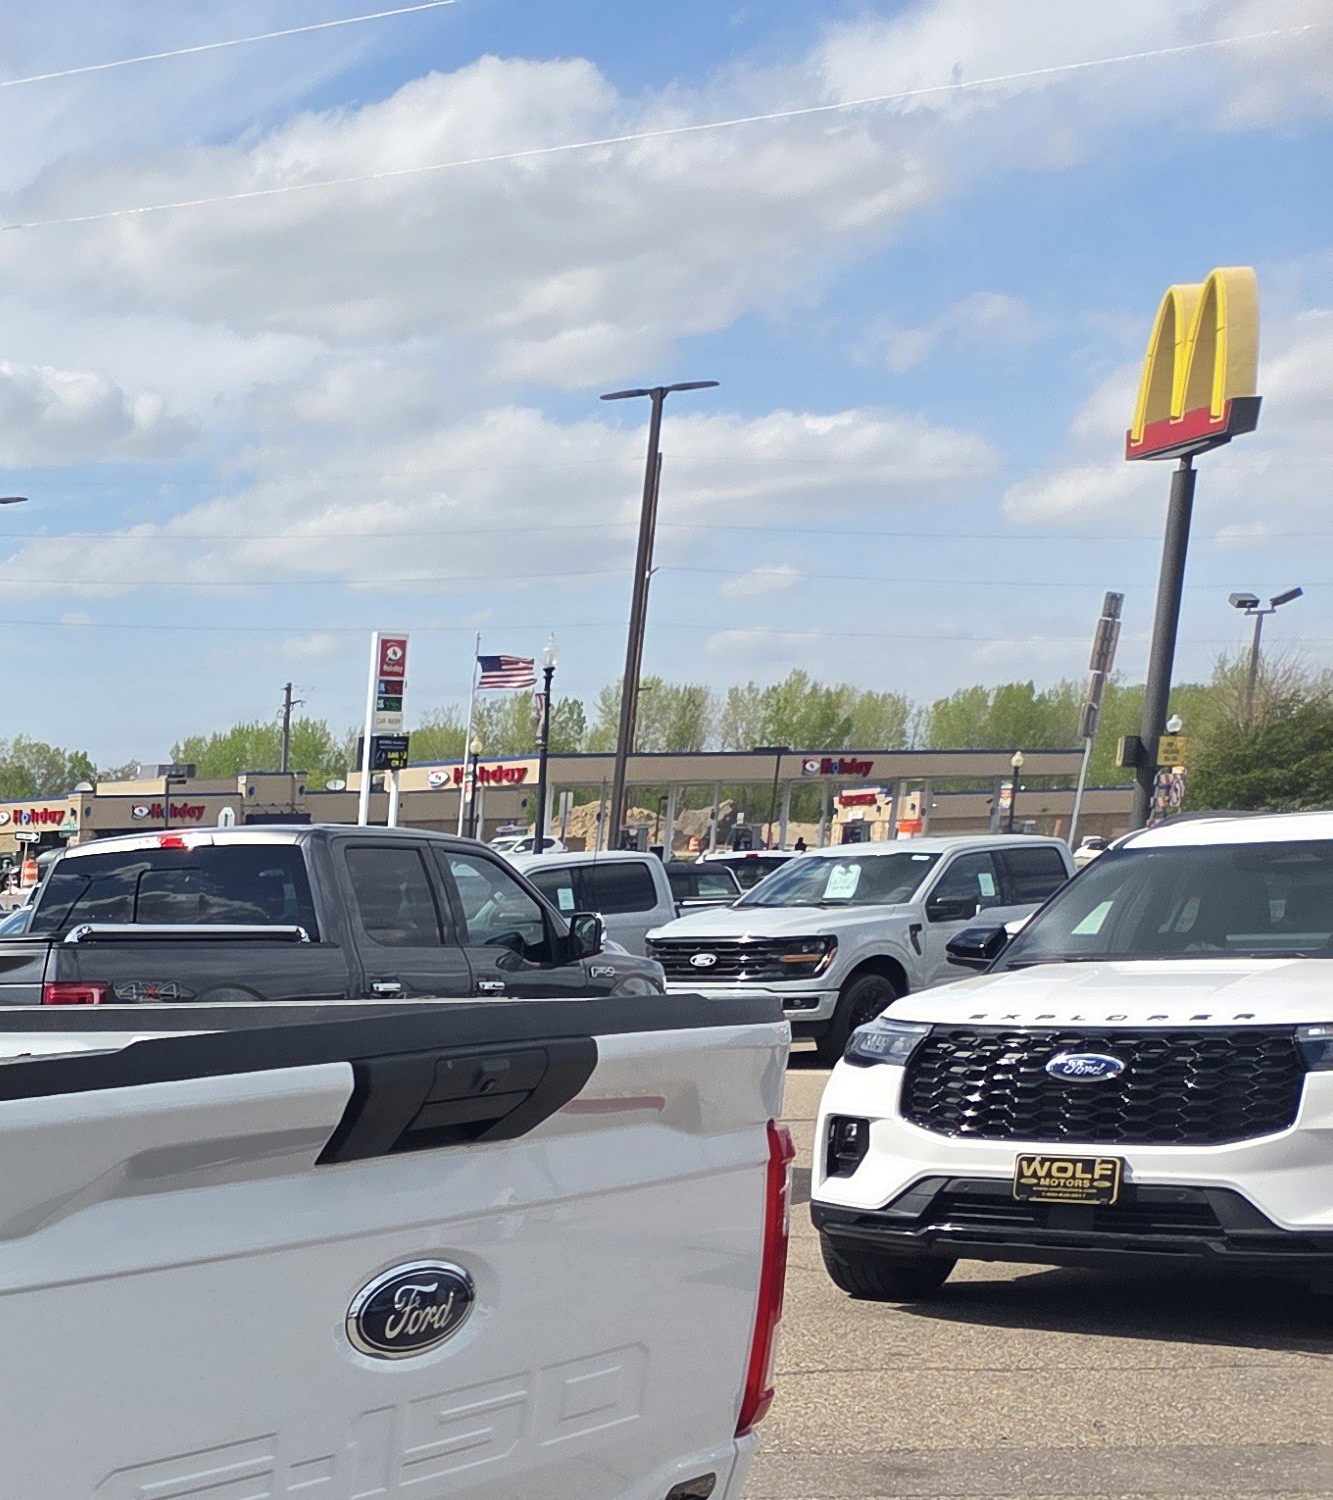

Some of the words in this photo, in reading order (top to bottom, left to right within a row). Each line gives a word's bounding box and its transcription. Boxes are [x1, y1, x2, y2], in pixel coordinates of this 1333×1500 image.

[453, 765, 528, 785] Hliday
[13, 807, 66, 826] Holiday
[968, 1013, 1256, 1021] EXPLORER
[1062, 1058, 1106, 1076] Ford
[1021, 1159, 1114, 1179] WOLF
[1039, 1178, 1090, 1188] MOTORS
[383, 1281, 454, 1339] Ford
